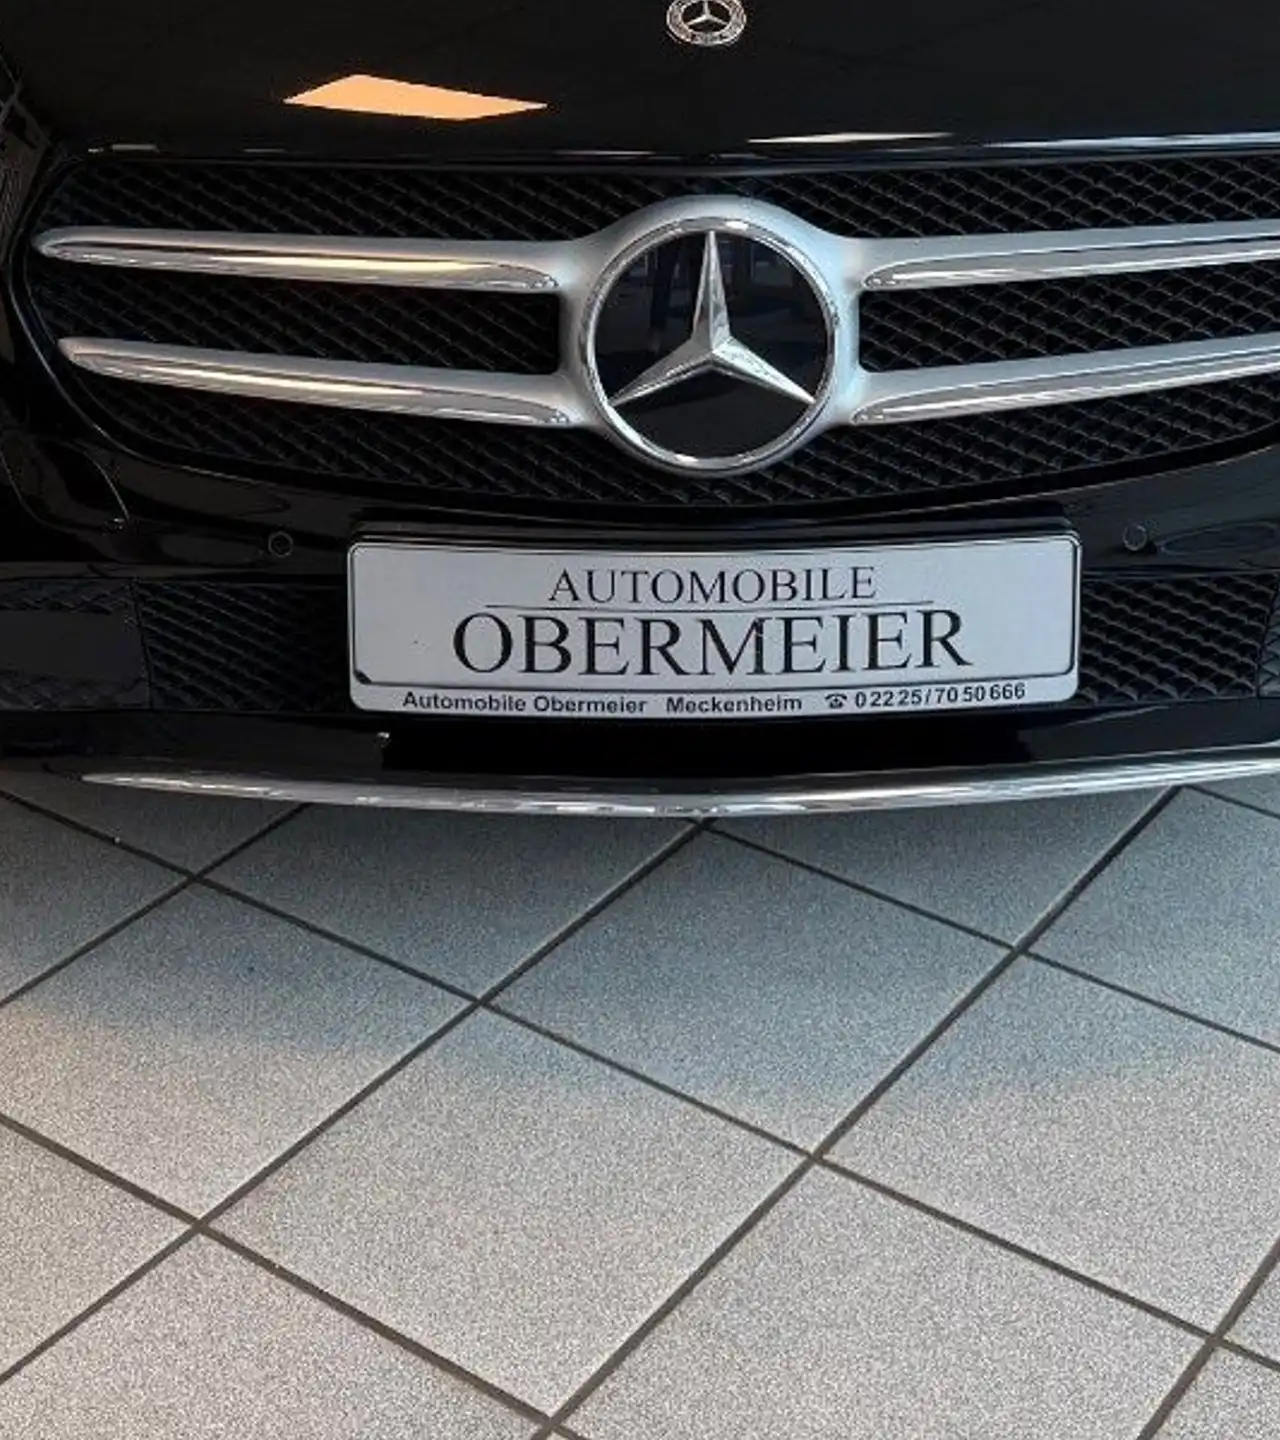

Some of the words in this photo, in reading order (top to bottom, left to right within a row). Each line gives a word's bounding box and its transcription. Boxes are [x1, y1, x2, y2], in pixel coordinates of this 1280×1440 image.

[547, 565, 878, 605] AUTOMOBILE
[452, 608, 974, 677] OBERMEIER
[402, 691, 527, 713] Automobile
[533, 695, 648, 714] Obermeier
[665, 694, 803, 714] Meckenheim
